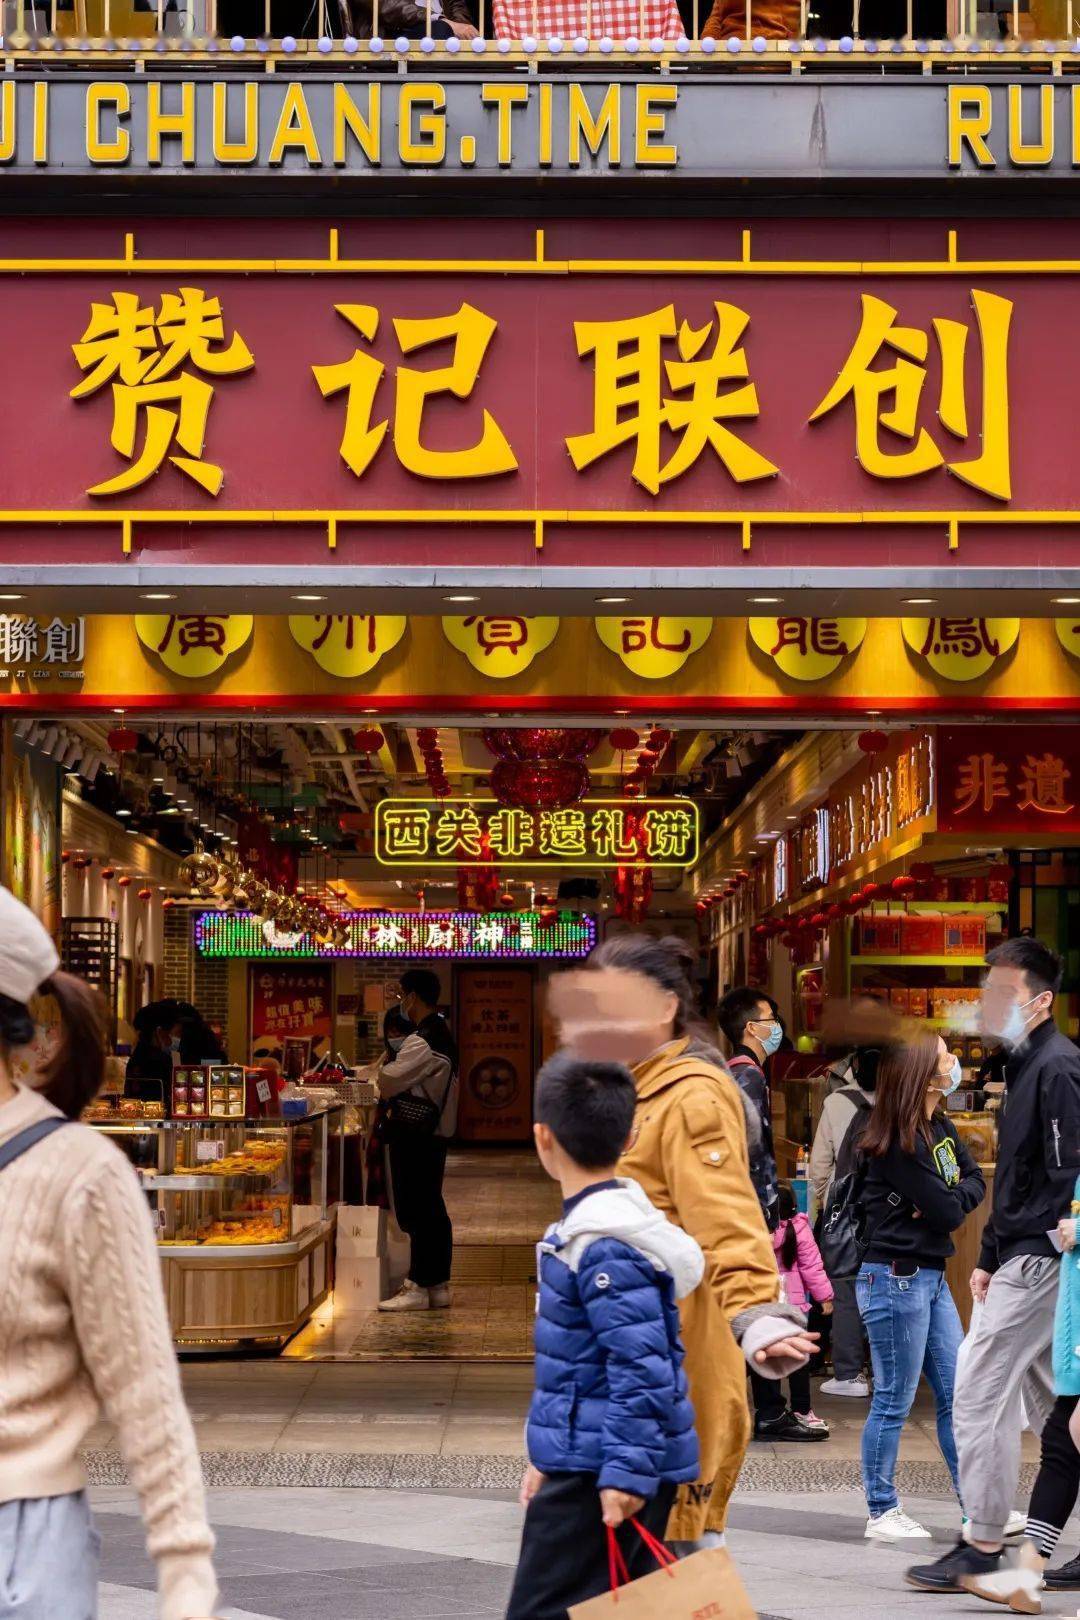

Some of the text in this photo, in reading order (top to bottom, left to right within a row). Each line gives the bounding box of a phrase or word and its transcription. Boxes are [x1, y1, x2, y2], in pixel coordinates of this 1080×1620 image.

[69, 287, 1014, 502] 赞记联创
[953, 752, 1074, 815] 非遺
[383, 808, 691, 857] 西关非遗礼饼
